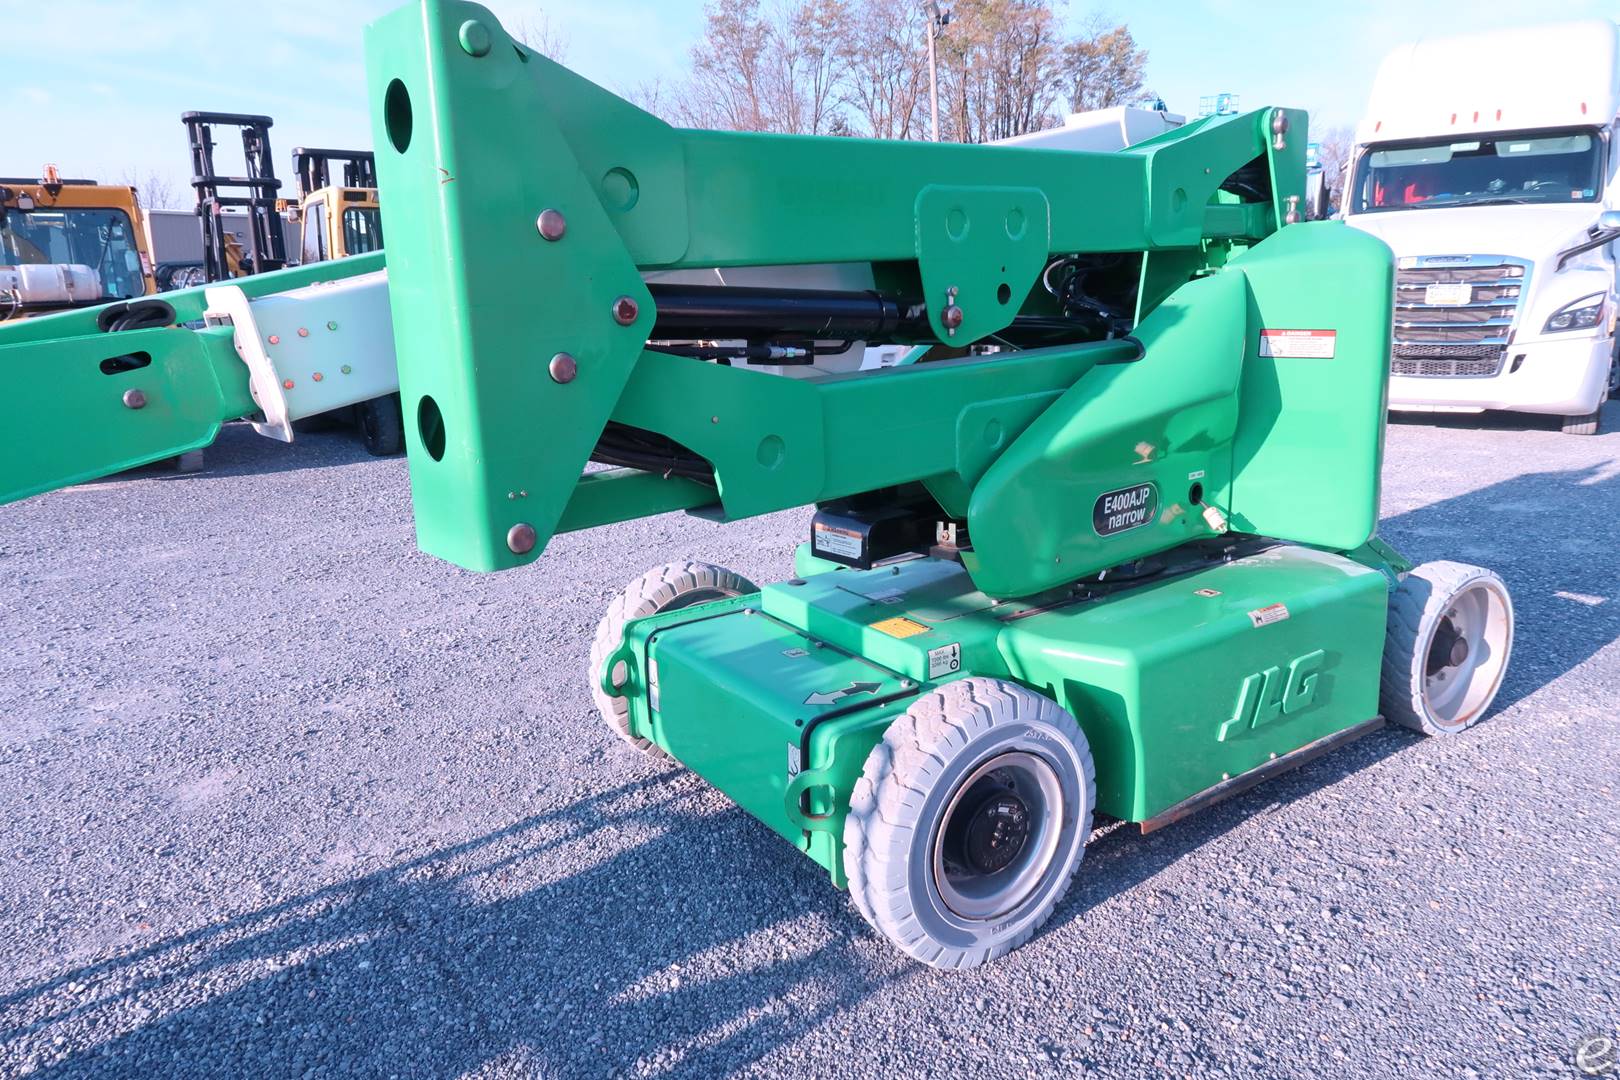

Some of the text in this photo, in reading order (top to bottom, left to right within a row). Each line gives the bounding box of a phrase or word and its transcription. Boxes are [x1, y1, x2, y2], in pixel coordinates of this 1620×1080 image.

[1104, 487, 1150, 514] E400AJP
[1108, 508, 1146, 530] narrow
[1217, 649, 1325, 742] JLG
